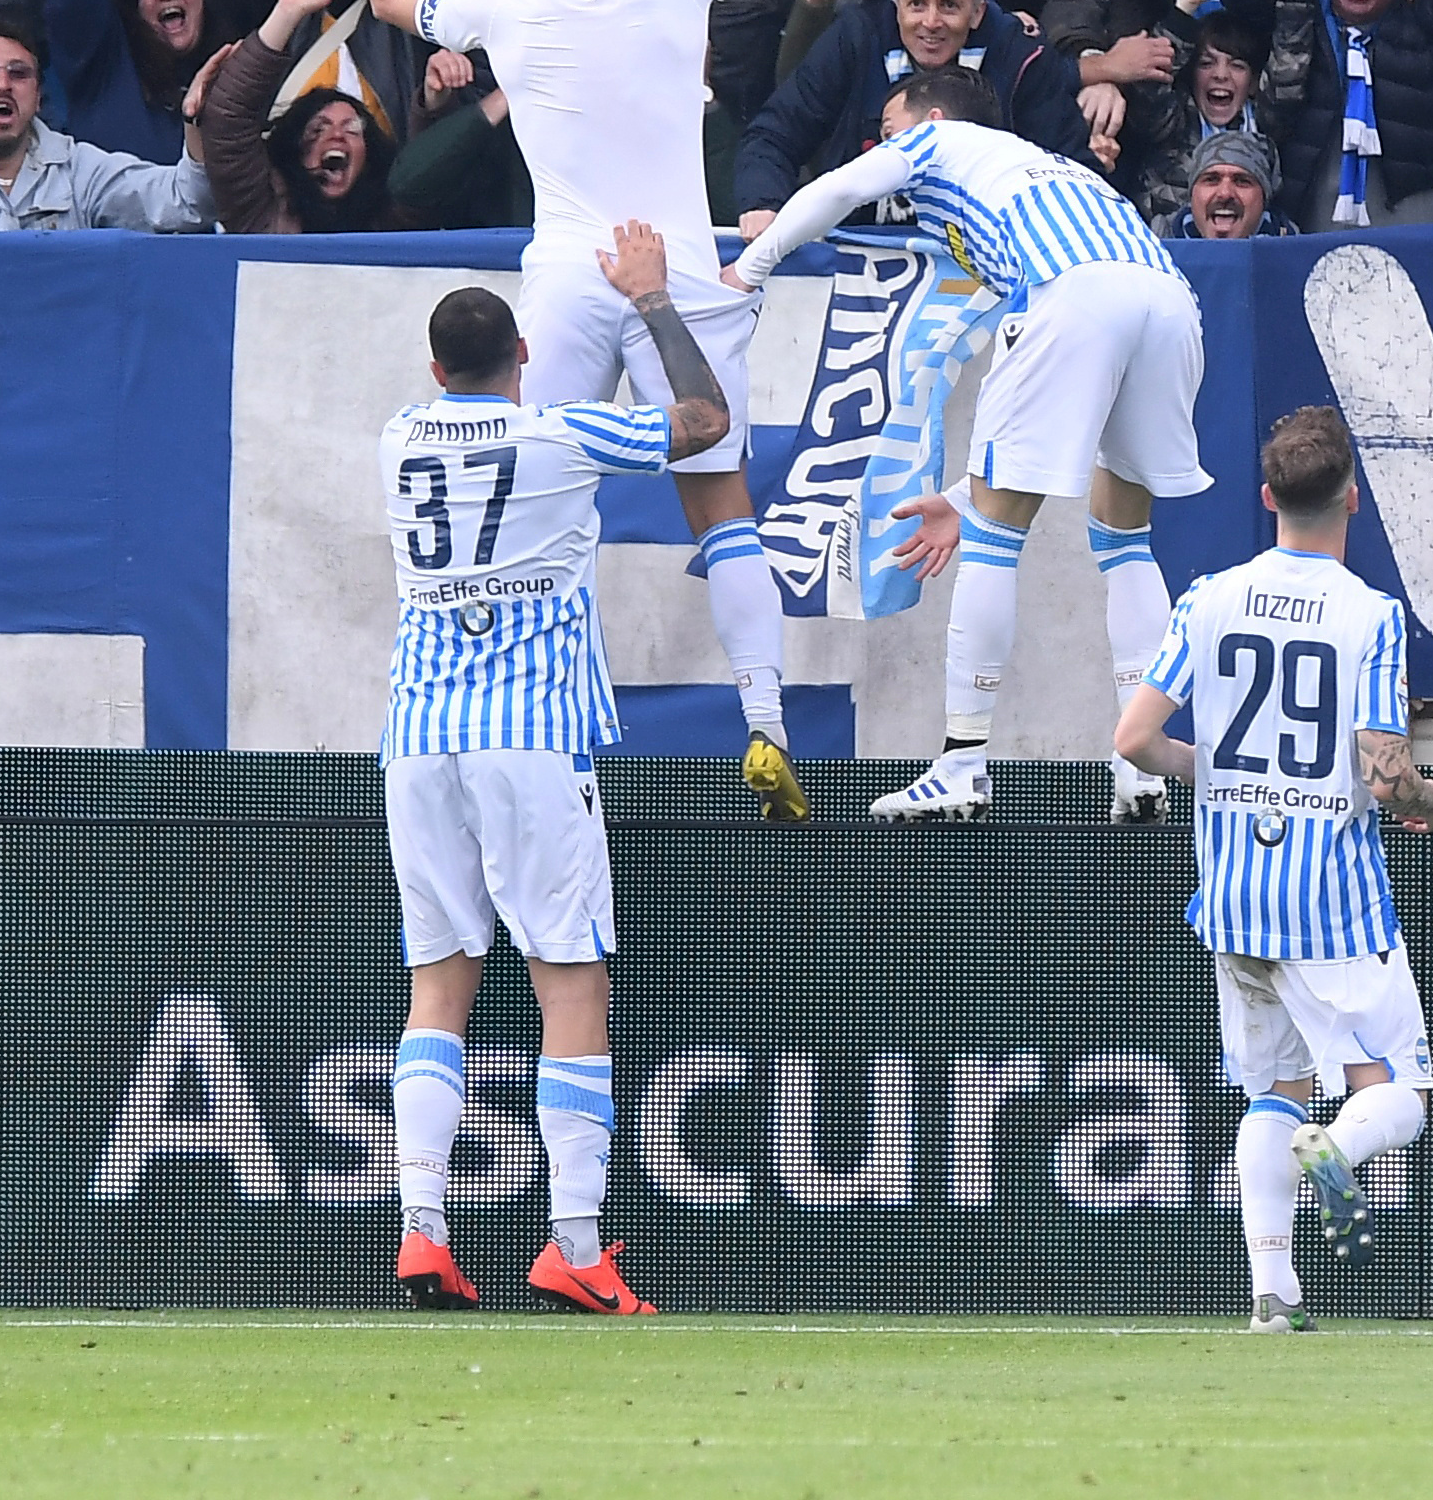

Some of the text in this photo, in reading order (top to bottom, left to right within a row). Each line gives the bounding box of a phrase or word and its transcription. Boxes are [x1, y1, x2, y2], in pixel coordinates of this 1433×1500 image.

[398, 446, 517, 570] 37
[409, 577, 554, 605] ErreEffe Group
[1245, 585, 1328, 625] lazzari
[1213, 632, 1338, 781] 29
[1206, 783, 1349, 816] ErreEffe Group
